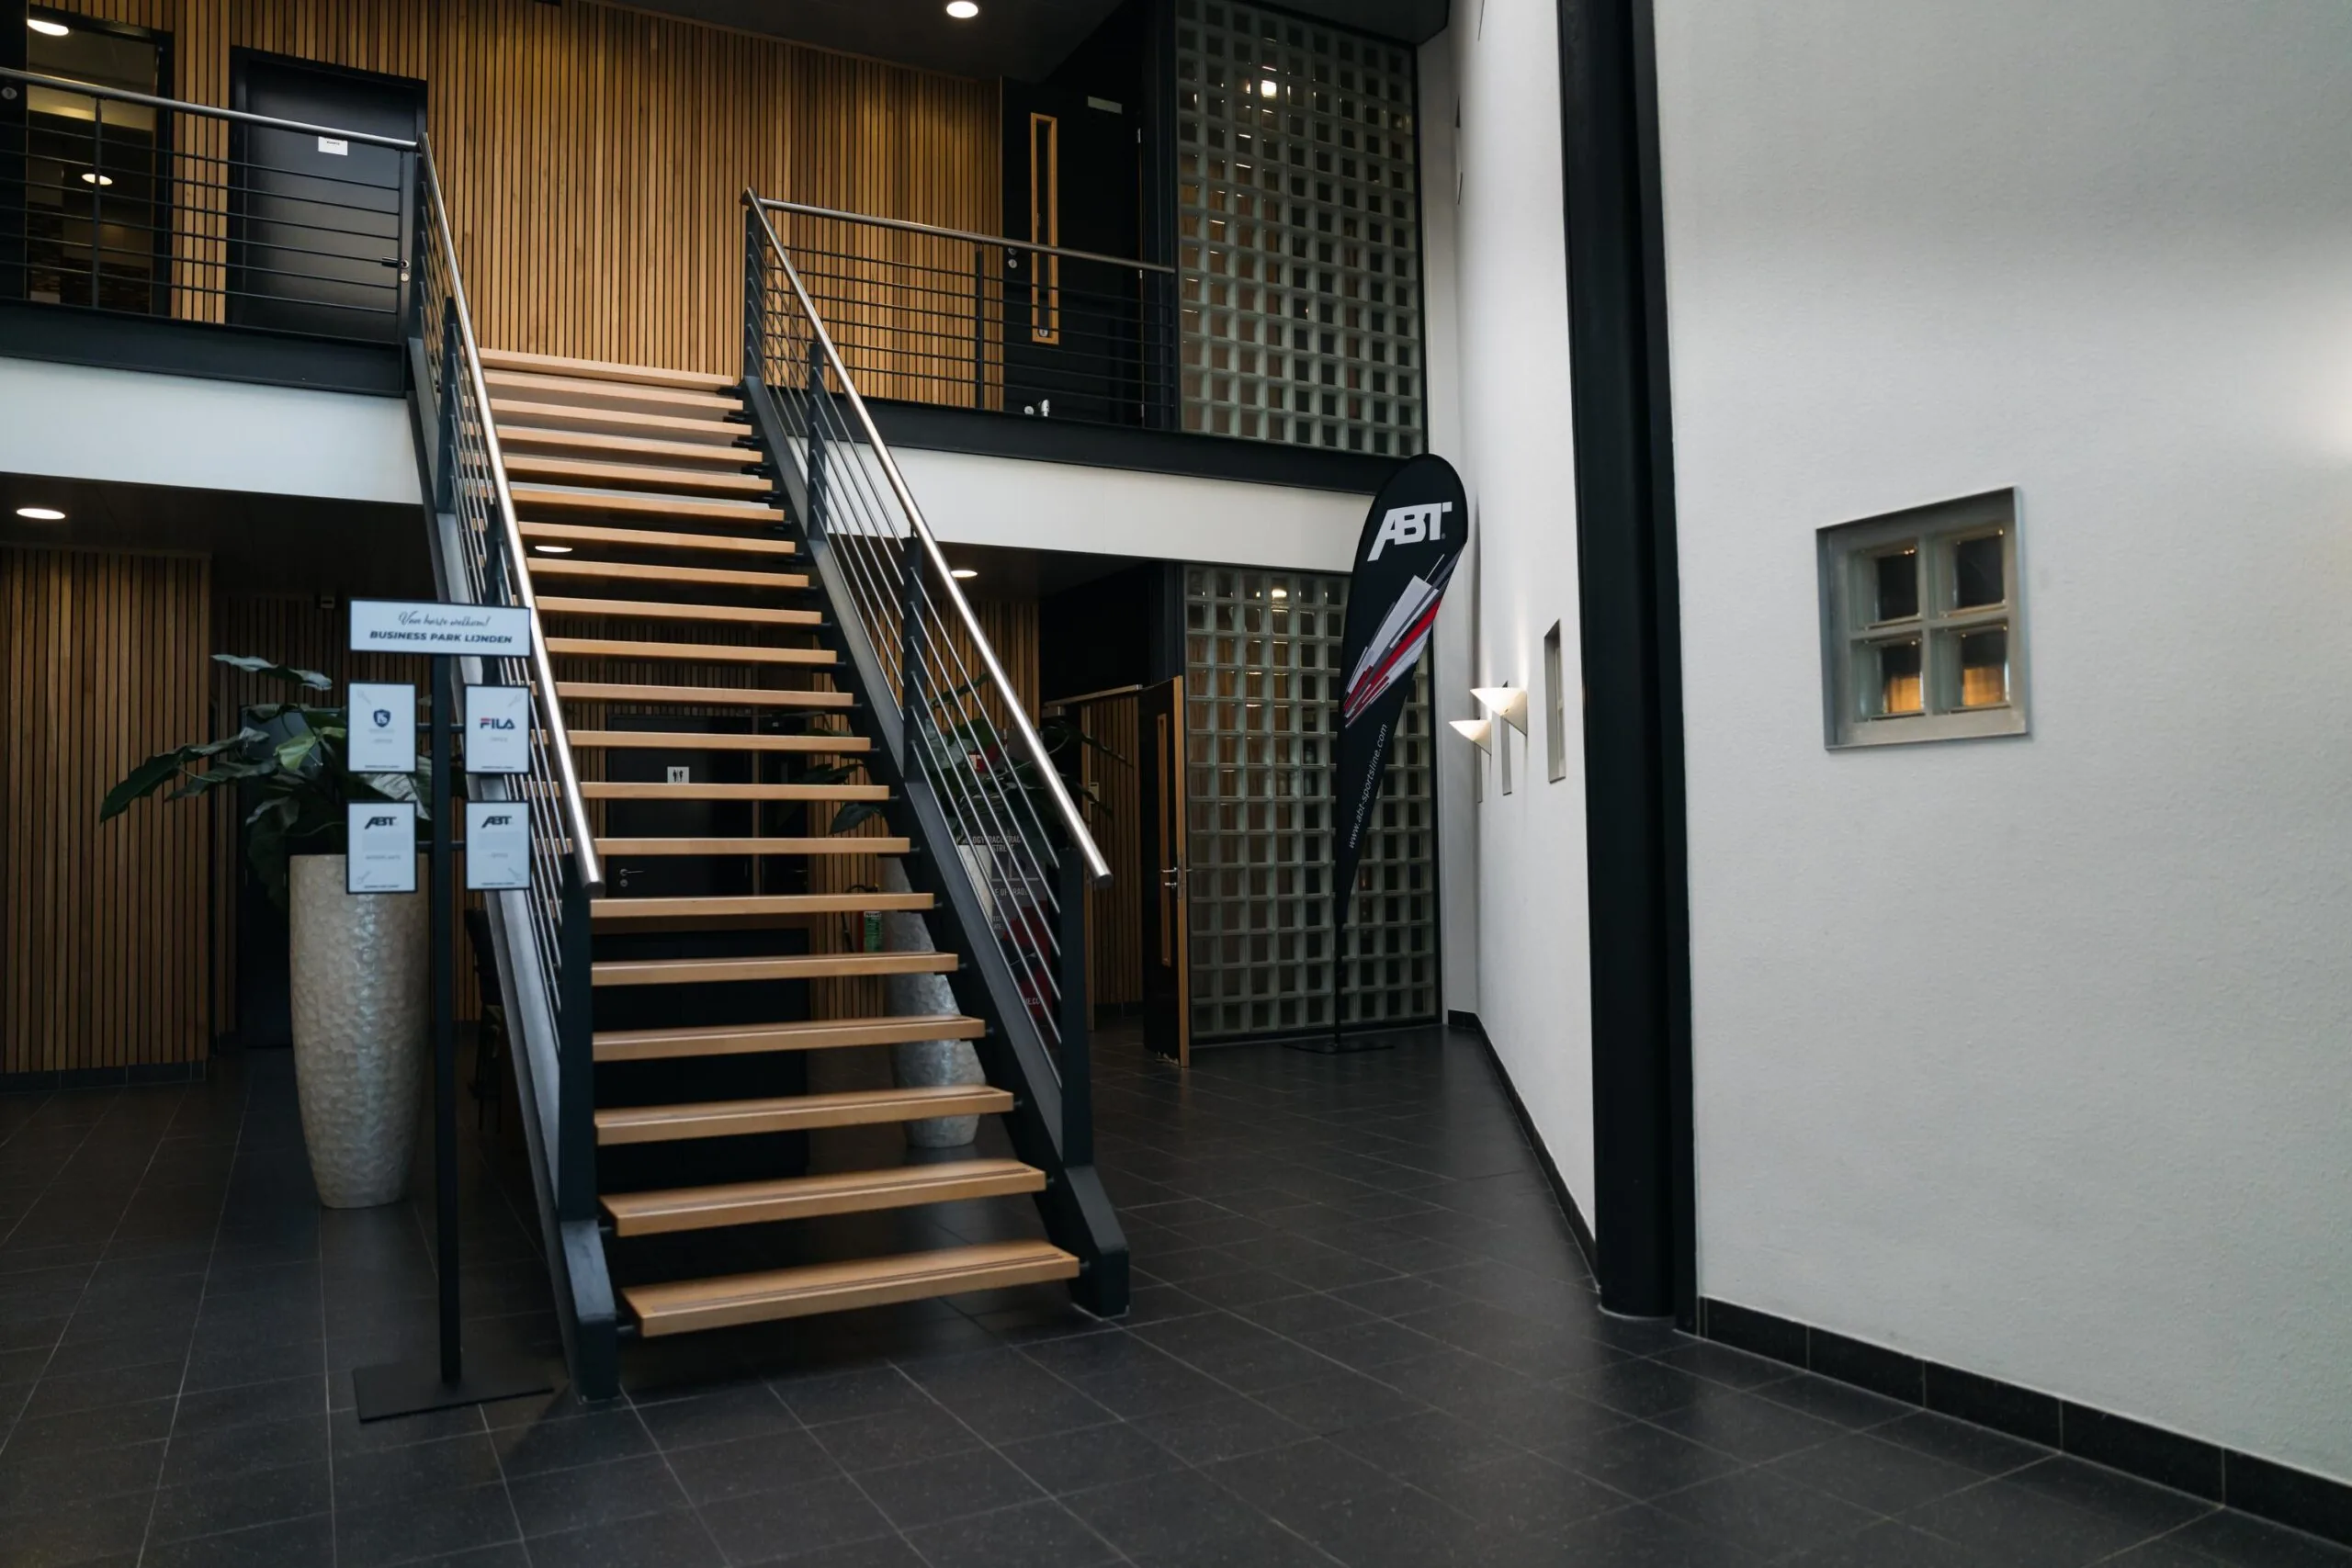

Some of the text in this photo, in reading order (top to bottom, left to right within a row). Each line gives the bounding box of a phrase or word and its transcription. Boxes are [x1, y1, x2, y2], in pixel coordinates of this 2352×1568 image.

[1367, 502, 1453, 562] ABT
[369, 630, 513, 644] BUSINESS PARK LIJNDEN
[480, 717, 515, 730] FILA
[1349, 723, 1388, 850] www.abt-sportsline.com
[365, 816, 397, 829] ABT
[481, 815, 512, 829] ABT
